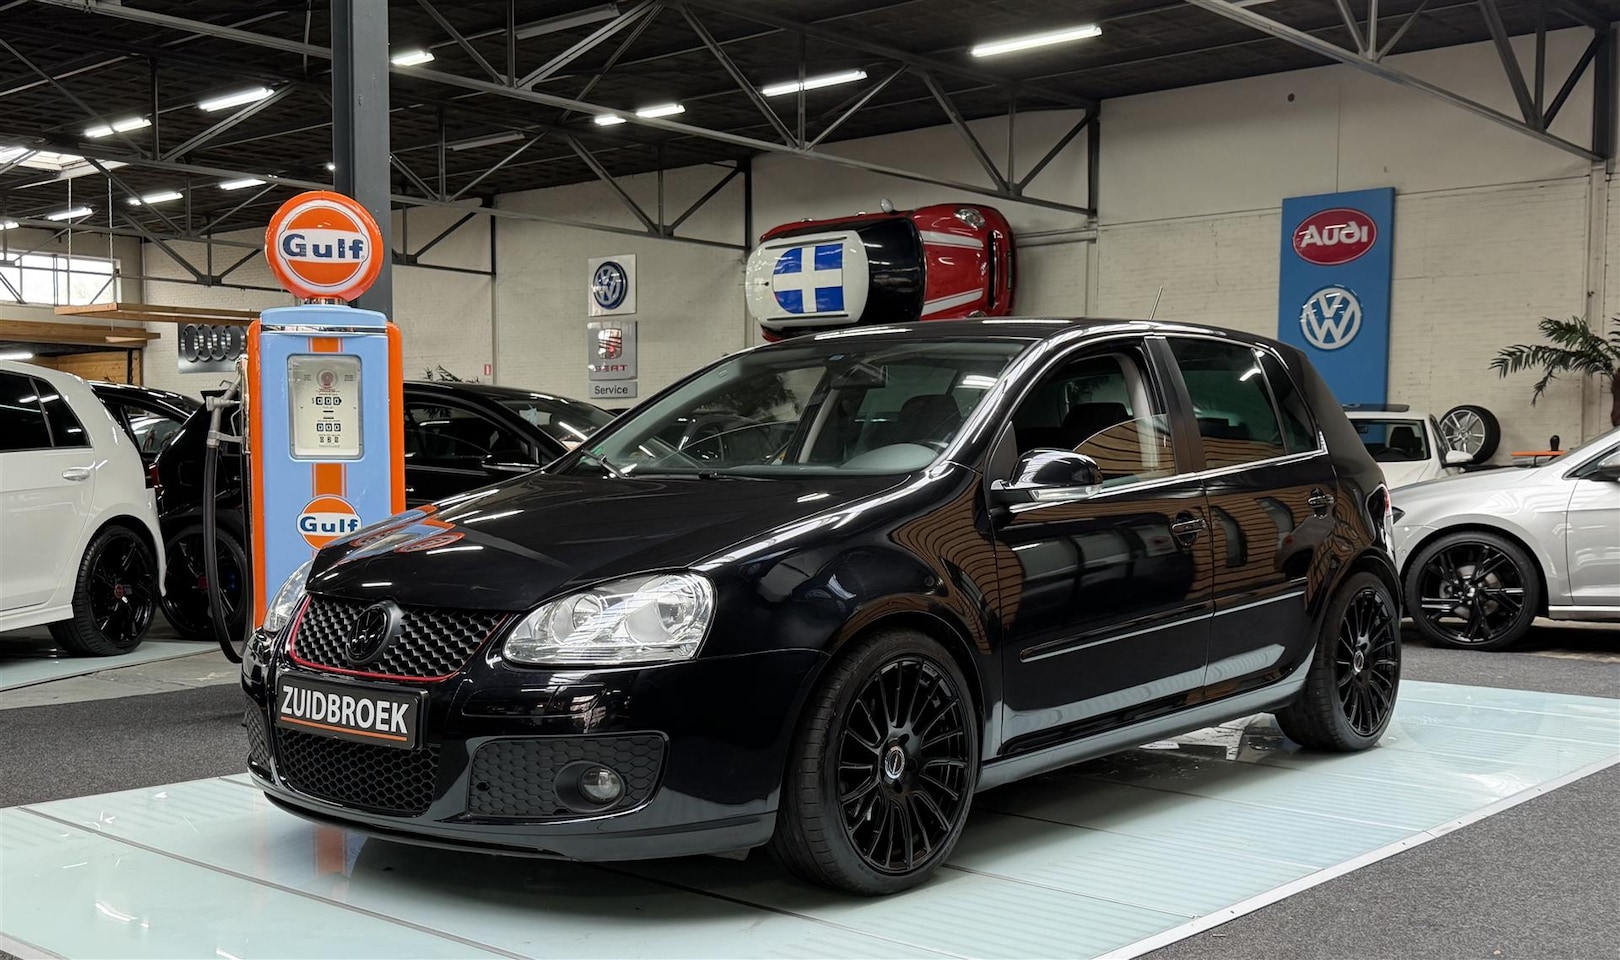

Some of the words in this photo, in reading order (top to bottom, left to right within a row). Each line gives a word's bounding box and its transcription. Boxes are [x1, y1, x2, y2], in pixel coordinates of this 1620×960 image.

[282, 233, 364, 260] Gulf
[594, 385, 628, 395] Service
[299, 516, 358, 533] Gulf
[280, 685, 410, 734] ZUIDBROEK
